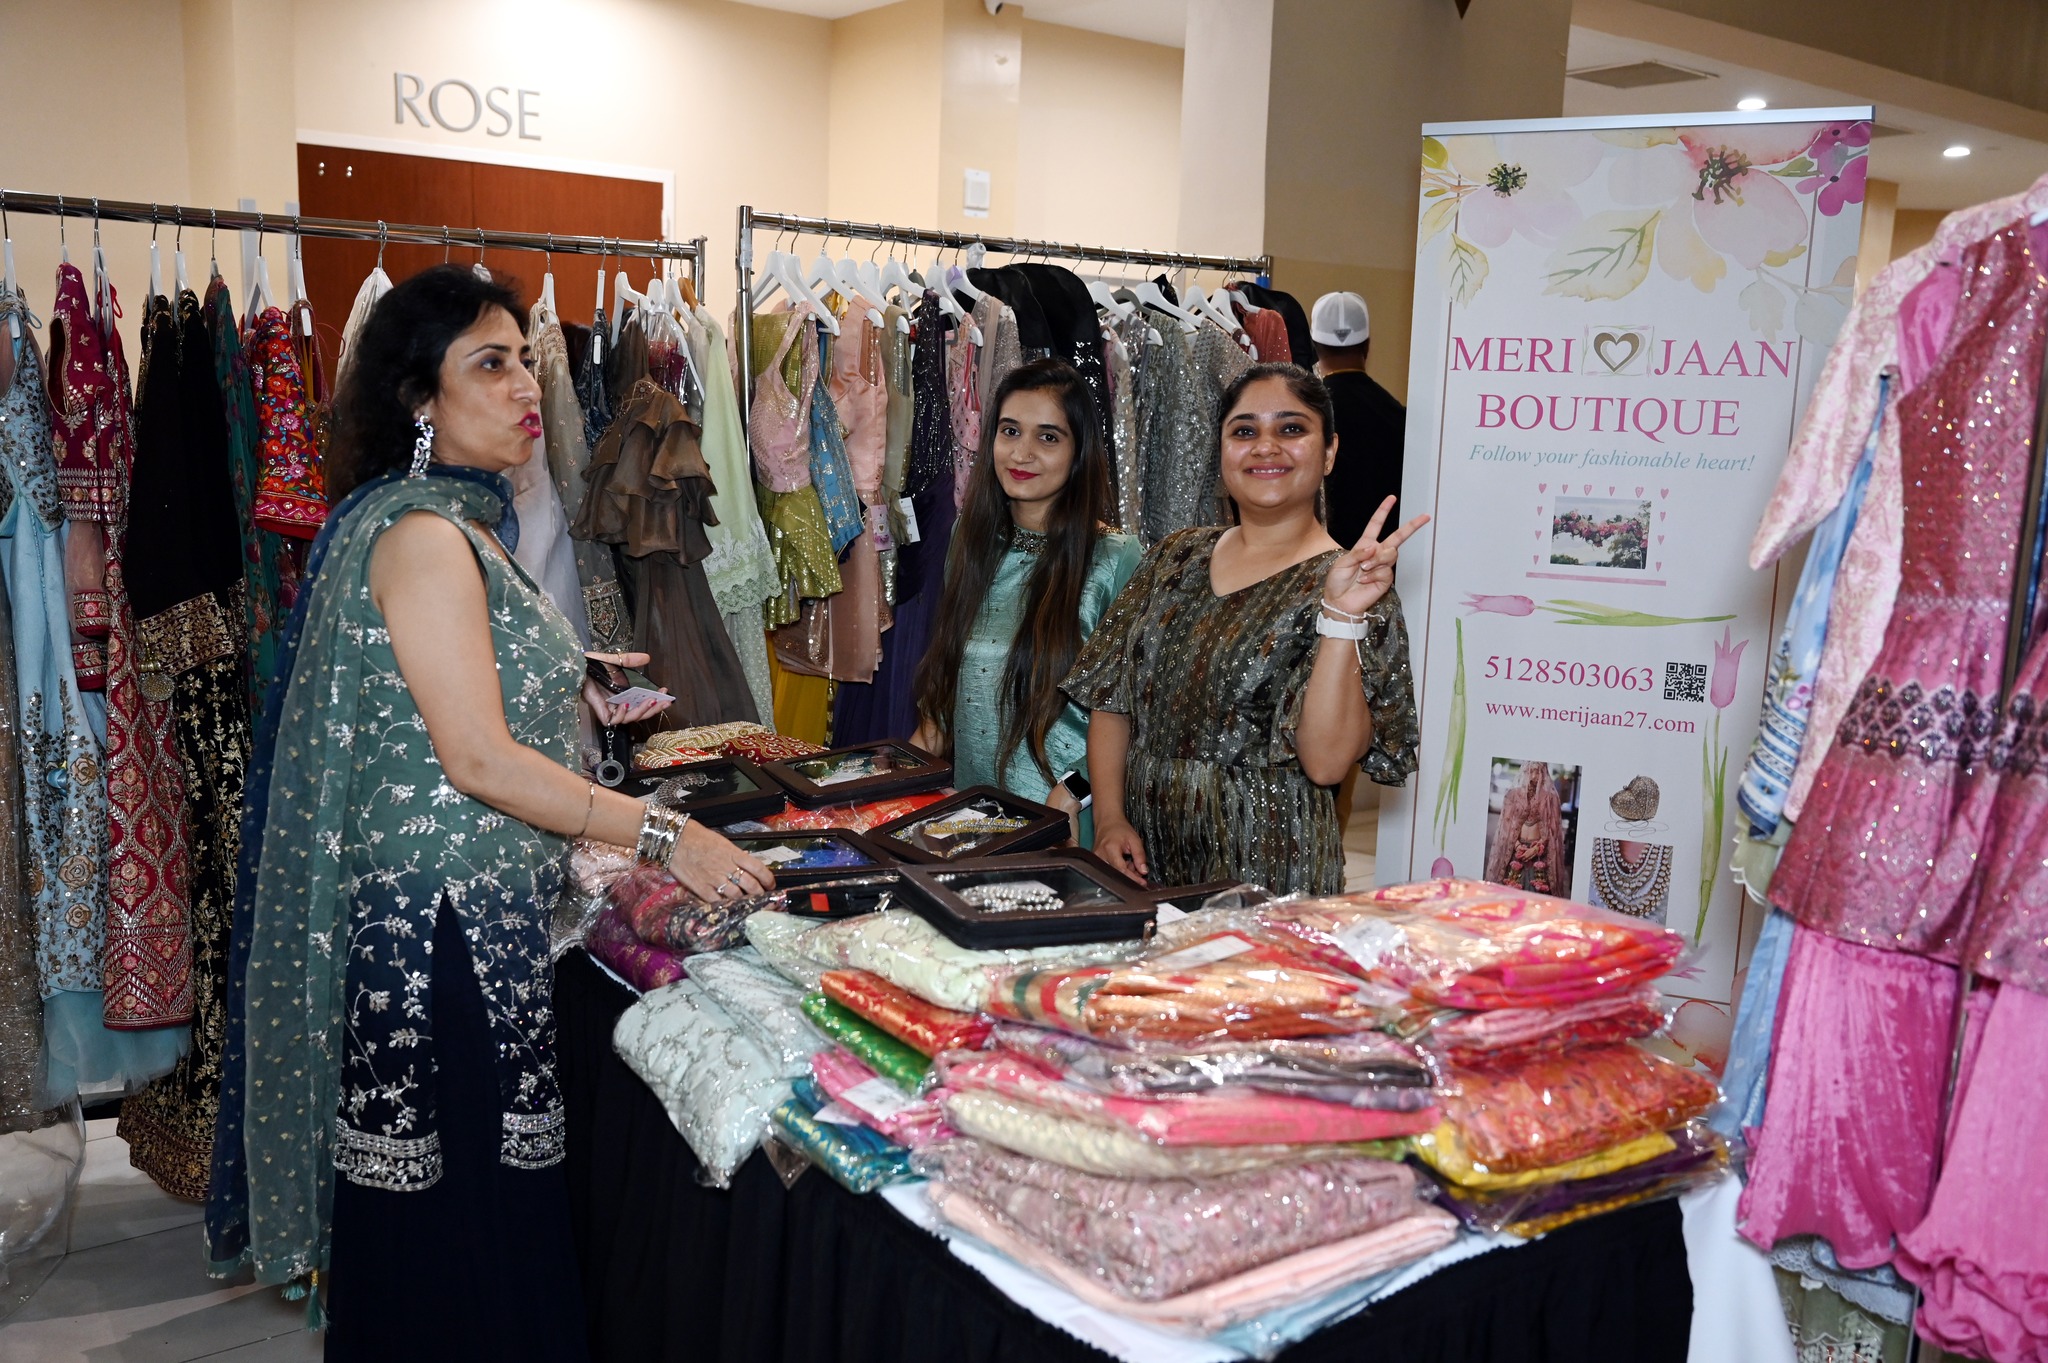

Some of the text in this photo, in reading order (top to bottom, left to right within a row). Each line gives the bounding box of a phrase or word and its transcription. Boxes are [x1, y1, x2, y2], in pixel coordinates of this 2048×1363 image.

[393, 71, 542, 141] ROSE
[1450, 336, 1796, 378] MERI JAAN
[1475, 393, 1740, 443] BOUTIQUE
[1469, 444, 1756, 471] Follow your fashionable heart!
[1485, 655, 1654, 692] 5128503063
[1485, 702, 1696, 734] www.merijaan27.com
